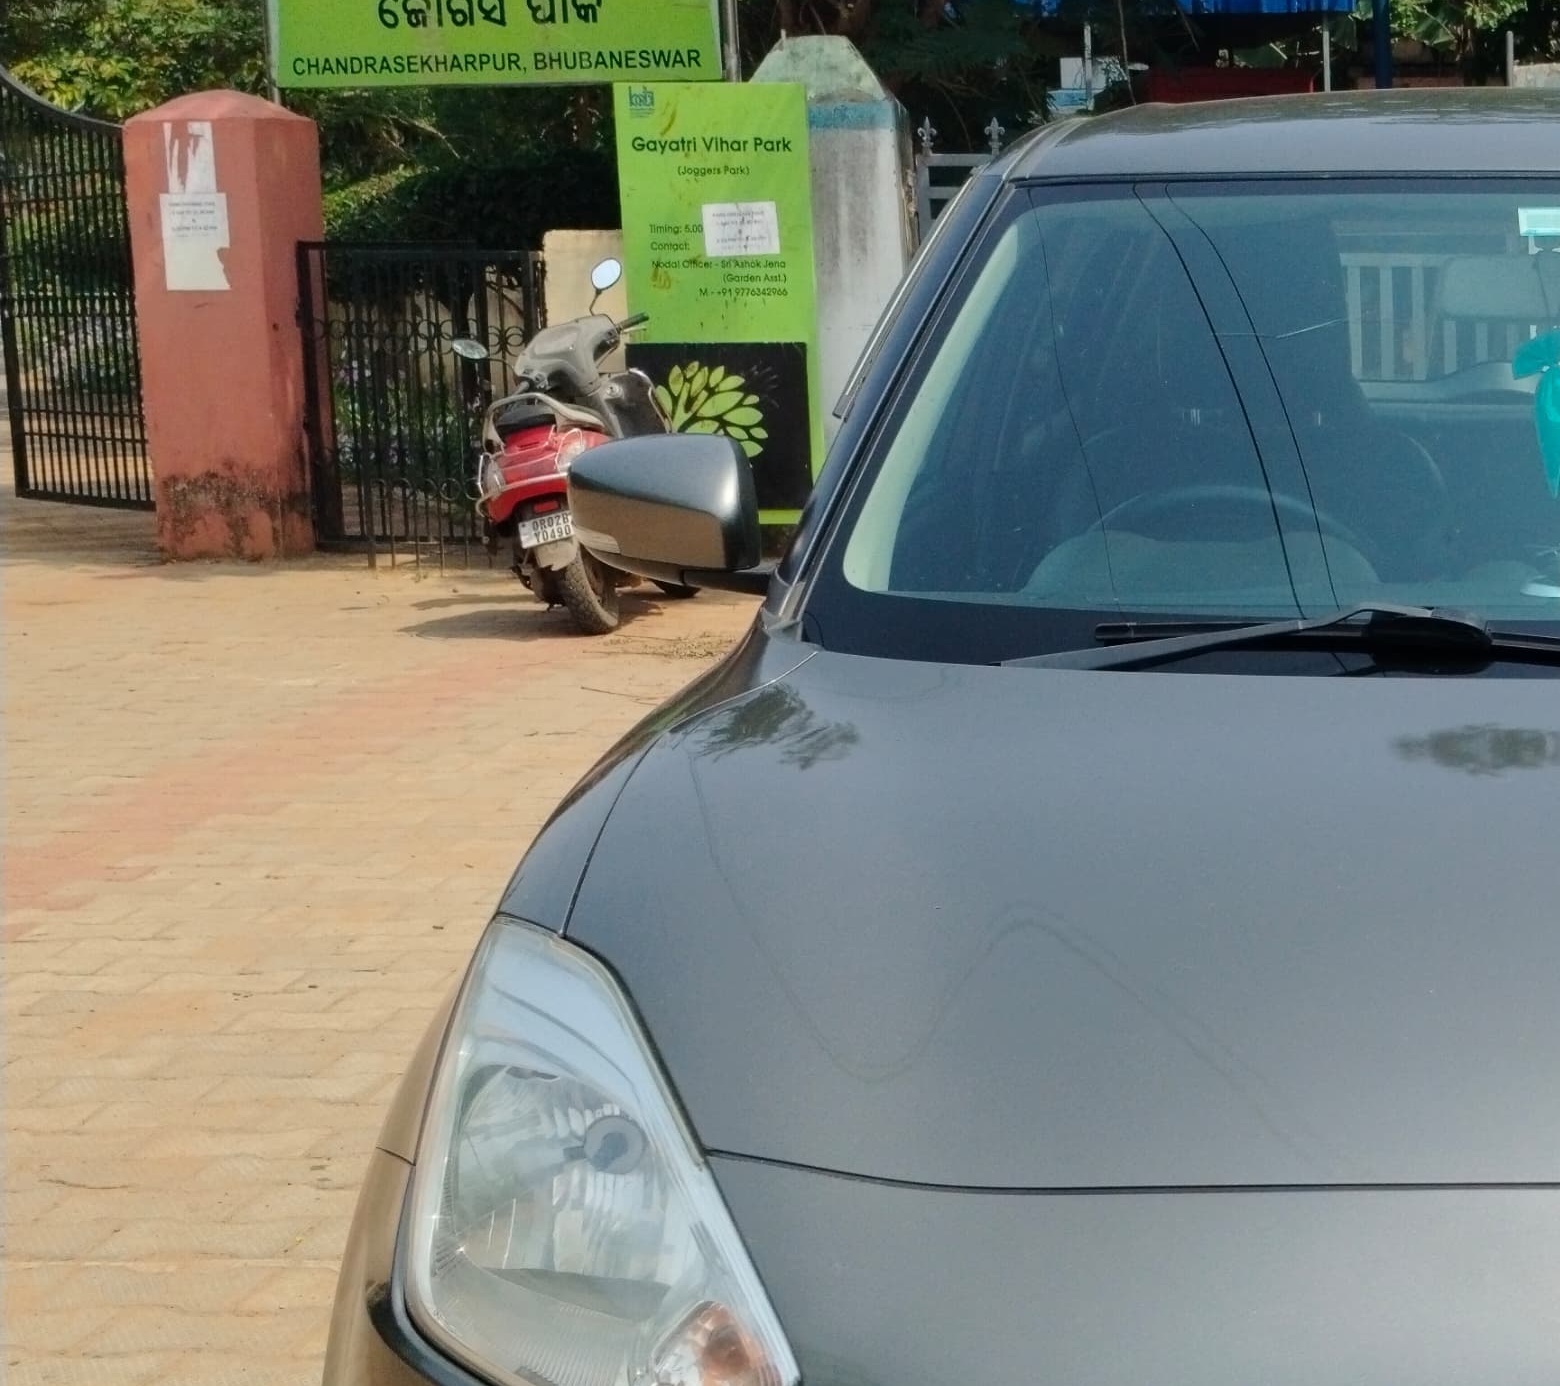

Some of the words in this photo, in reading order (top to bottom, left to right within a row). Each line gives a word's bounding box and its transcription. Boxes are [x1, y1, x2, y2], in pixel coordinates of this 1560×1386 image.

[292, 51, 528, 76] CHANDRASEKHARPUR,
[533, 48, 702, 71] BHUBANESWAR
[631, 136, 697, 155] Gayatri
[701, 136, 749, 153] Vihar
[753, 136, 793, 153] Park
[677, 165, 721, 177] (Joggers
[723, 165, 750, 176] Park)
[650, 241, 691, 251] Contact:
[722, 273, 761, 284] (Garden
